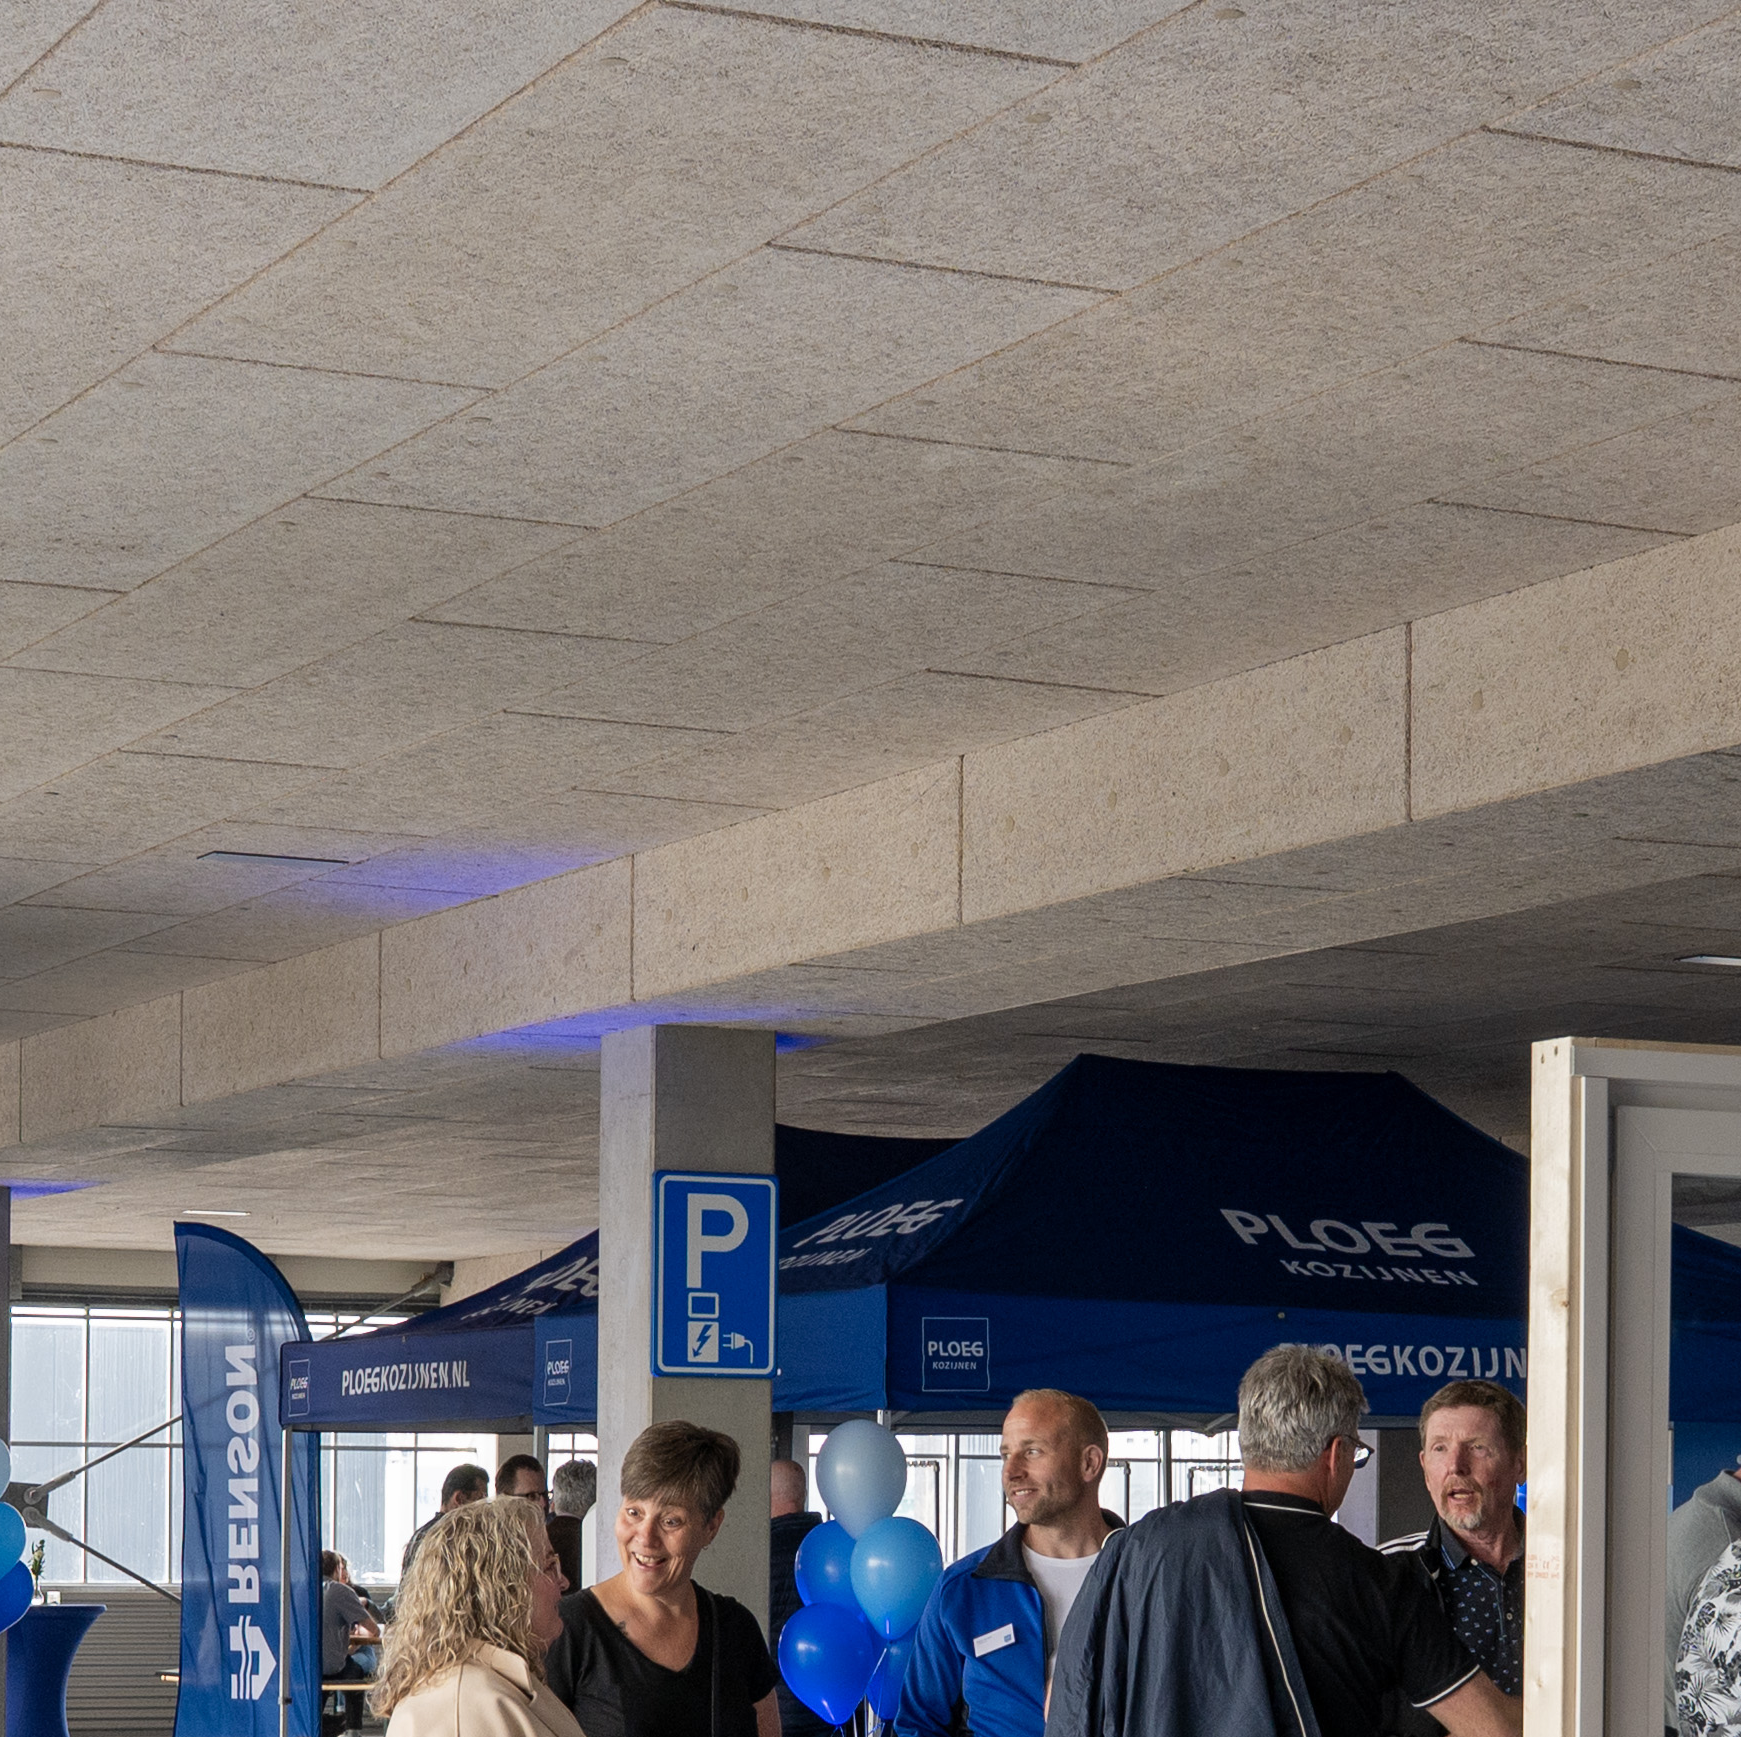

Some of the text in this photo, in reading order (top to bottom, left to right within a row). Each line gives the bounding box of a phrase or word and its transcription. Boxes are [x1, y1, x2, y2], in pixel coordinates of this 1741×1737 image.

[792, 1198, 964, 1248] PLOEG
[1220, 1208, 1475, 1259] PLOEG
[686, 1192, 749, 1289] P
[1280, 1259, 1479, 1286] KOZIJNEN
[928, 1341, 984, 1357] PLOEG
[341, 1360, 471, 1397] PLOEGKOZIJNEN.NL
[547, 1360, 570, 1375] PLOEG
[932, 1361, 977, 1370] KOZIJNEN
